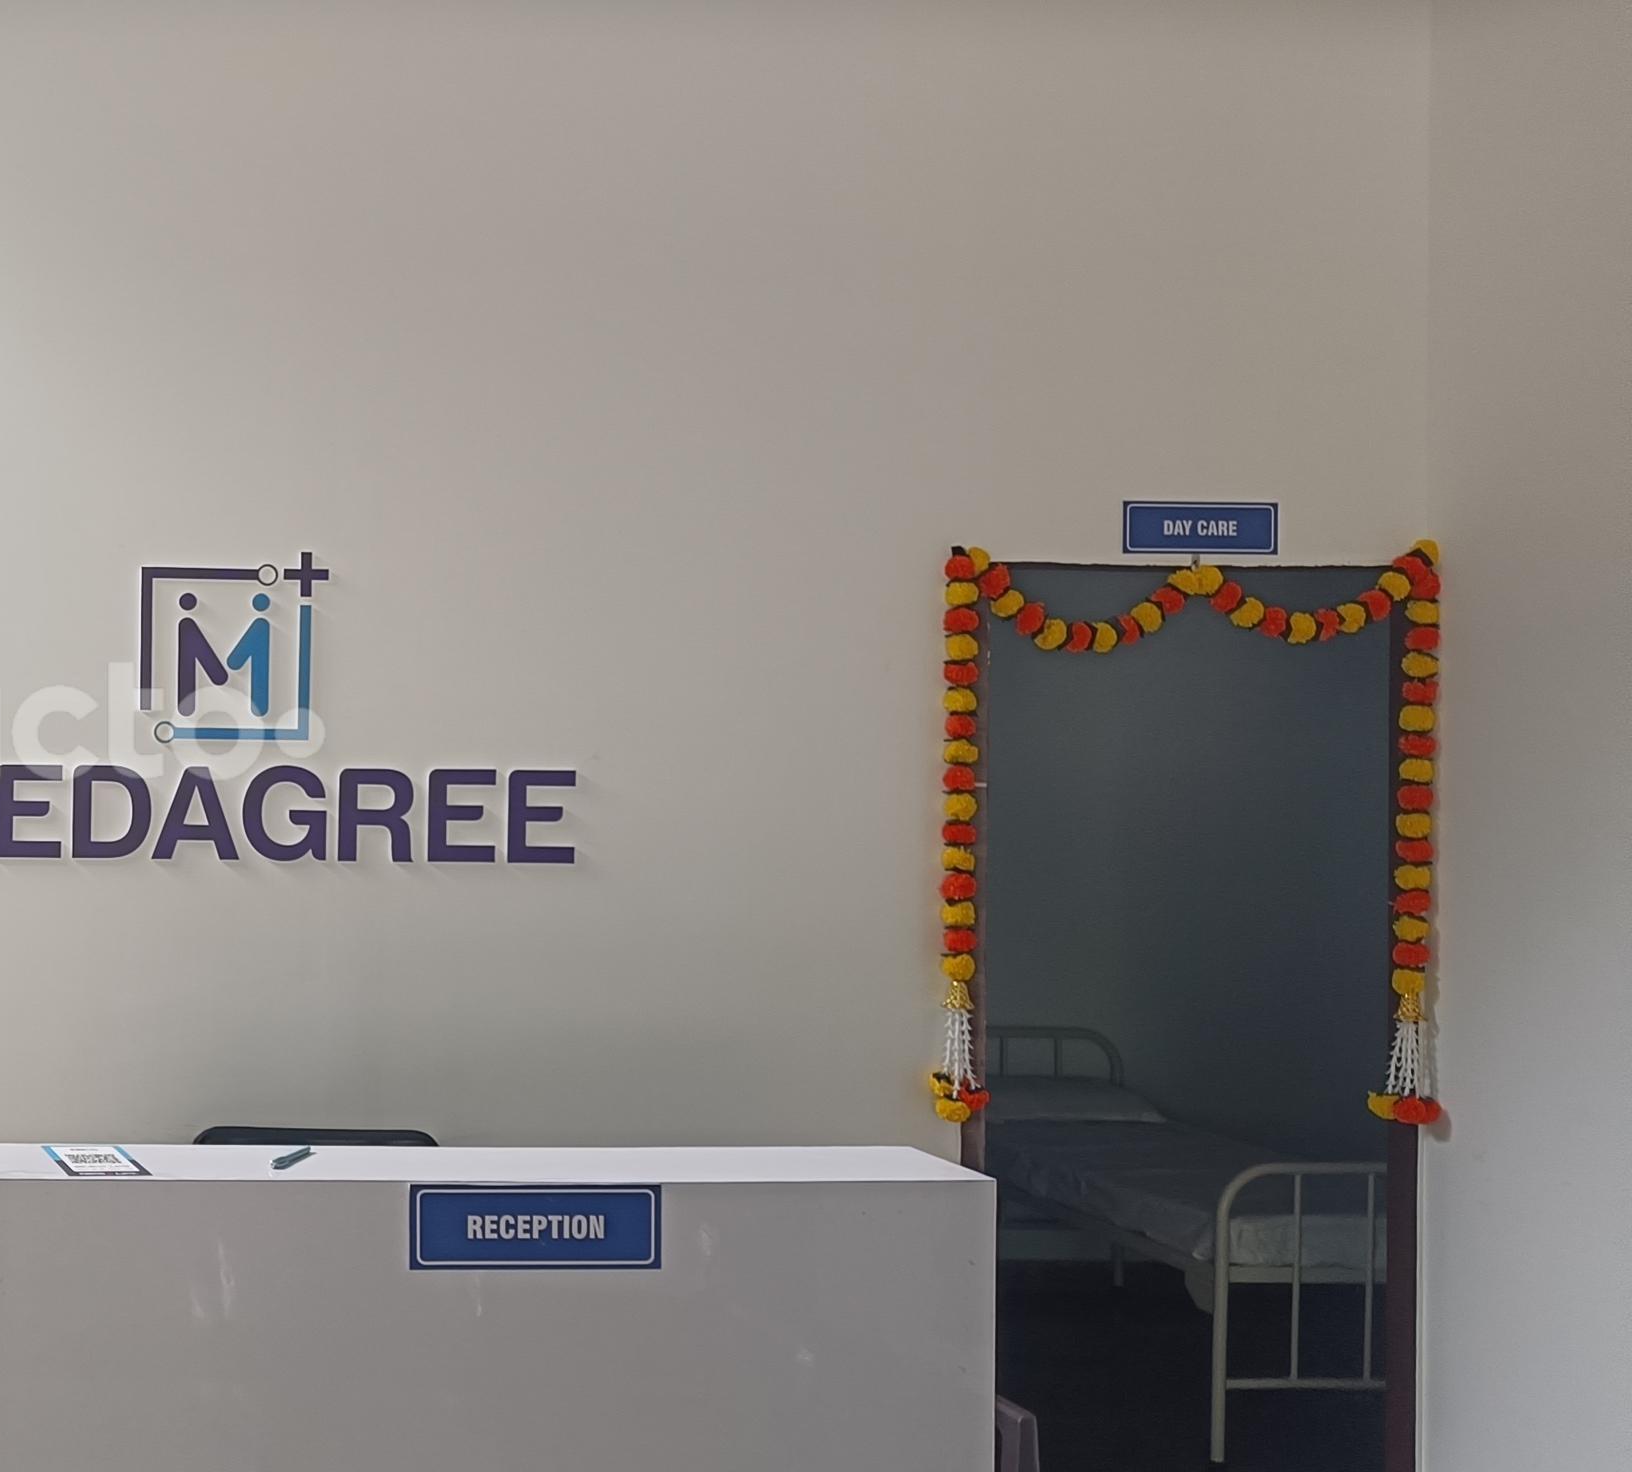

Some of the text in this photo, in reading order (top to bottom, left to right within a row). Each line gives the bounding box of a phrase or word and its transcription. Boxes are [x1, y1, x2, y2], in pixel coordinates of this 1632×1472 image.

[1163, 520, 1238, 537] DAY CARE
[467, 1215, 605, 1240] RECEPTION
